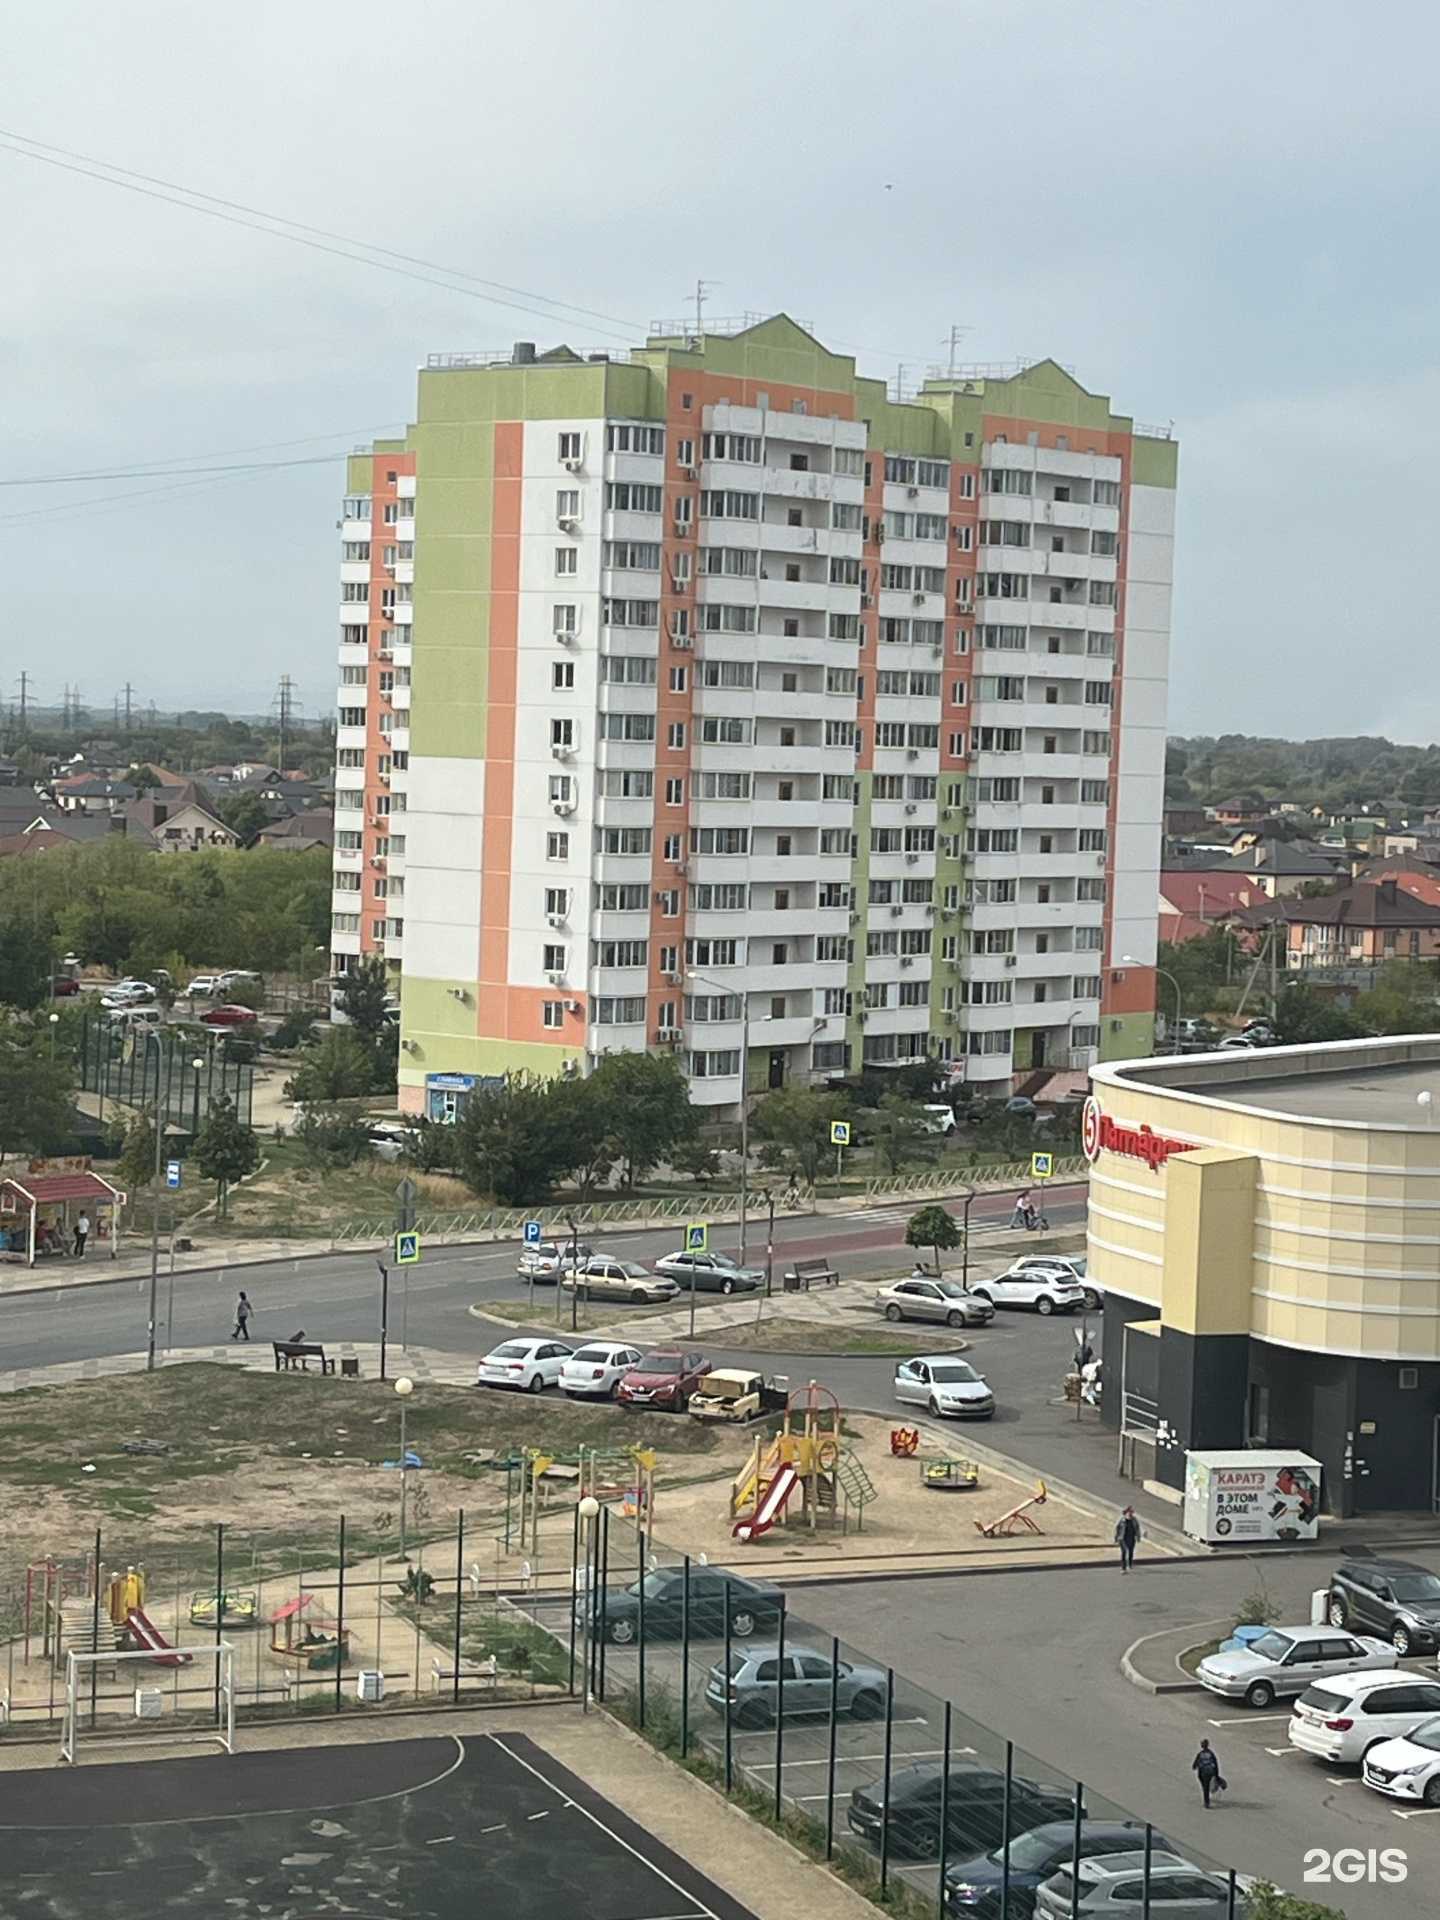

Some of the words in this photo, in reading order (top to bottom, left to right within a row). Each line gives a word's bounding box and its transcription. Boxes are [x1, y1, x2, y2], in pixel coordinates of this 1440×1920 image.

[528, 1223, 538, 1240] P
[1217, 1472, 1265, 1484] КАРАТЭ
[1217, 1494, 1224, 1503] В
[1227, 1493, 1258, 1503] ЭТОМ
[1216, 1504, 1249, 1516] ДОМЕ
